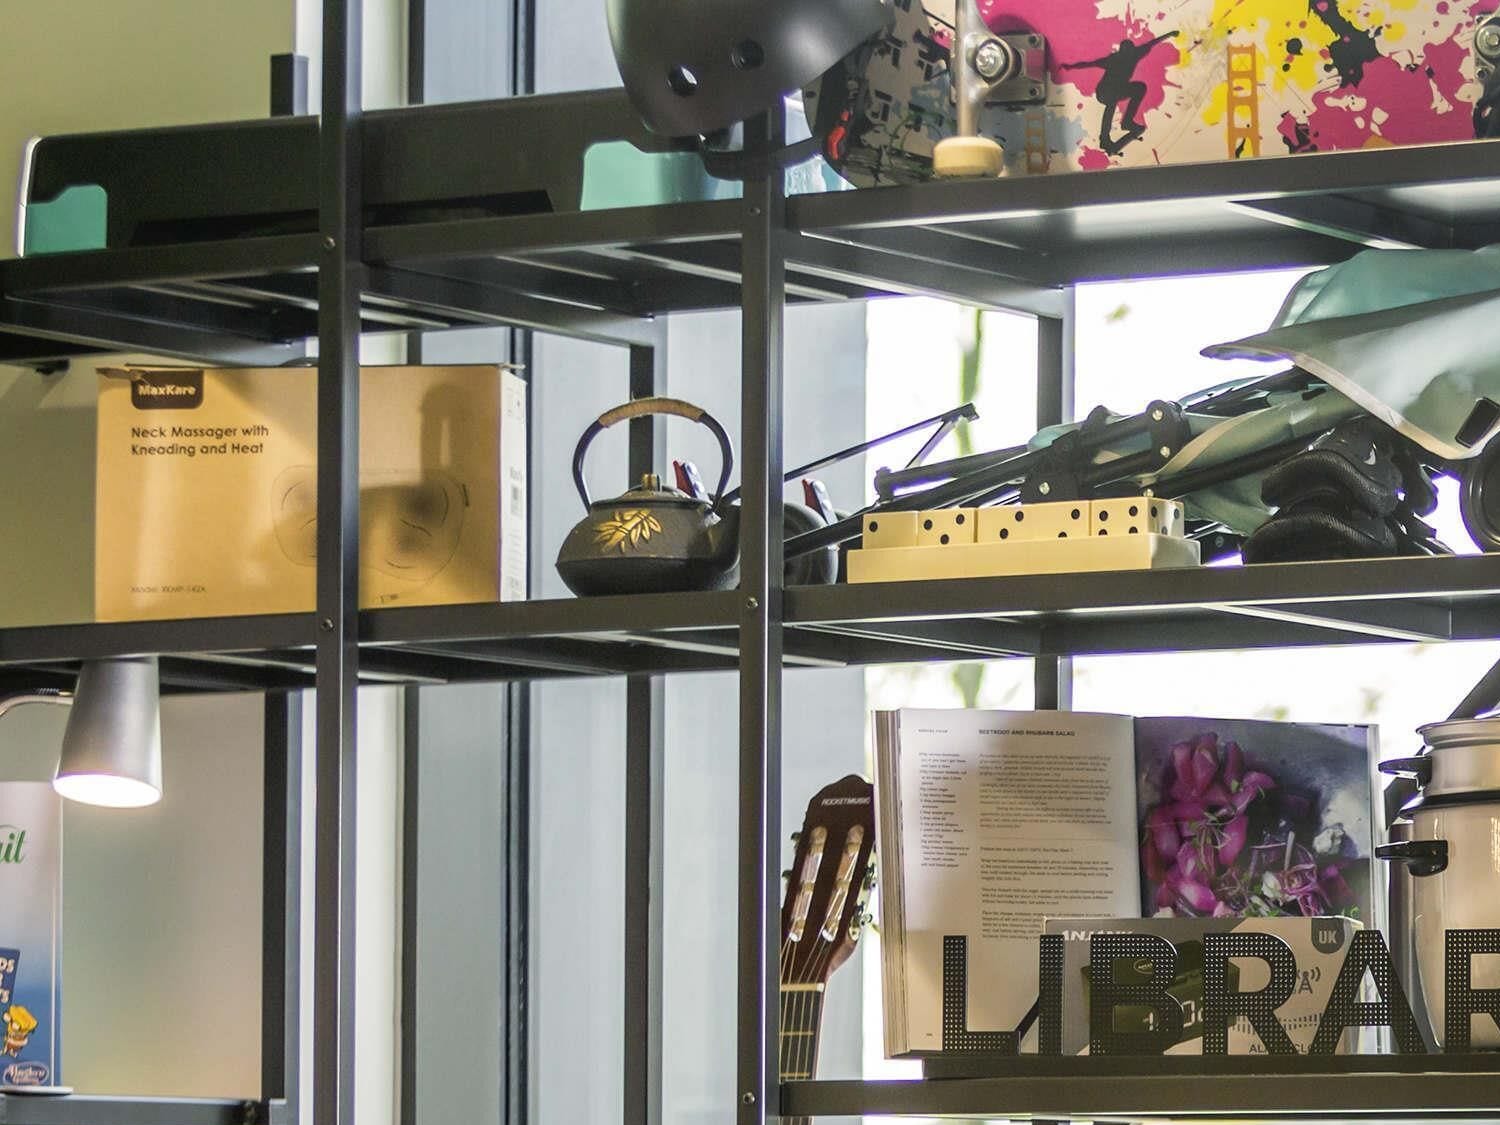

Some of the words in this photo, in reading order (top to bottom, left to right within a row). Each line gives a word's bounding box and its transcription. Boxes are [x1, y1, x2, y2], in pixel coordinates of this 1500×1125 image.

[138, 384, 196, 396] MaxKare
[131, 426, 167, 439] Neck
[171, 425, 238, 440] Massager
[241, 424, 269, 437] with
[131, 444, 196, 457] Kneading
[200, 442, 227, 454] and
[231, 442, 264, 454] Heat
[1318, 930, 1338, 944] UK
